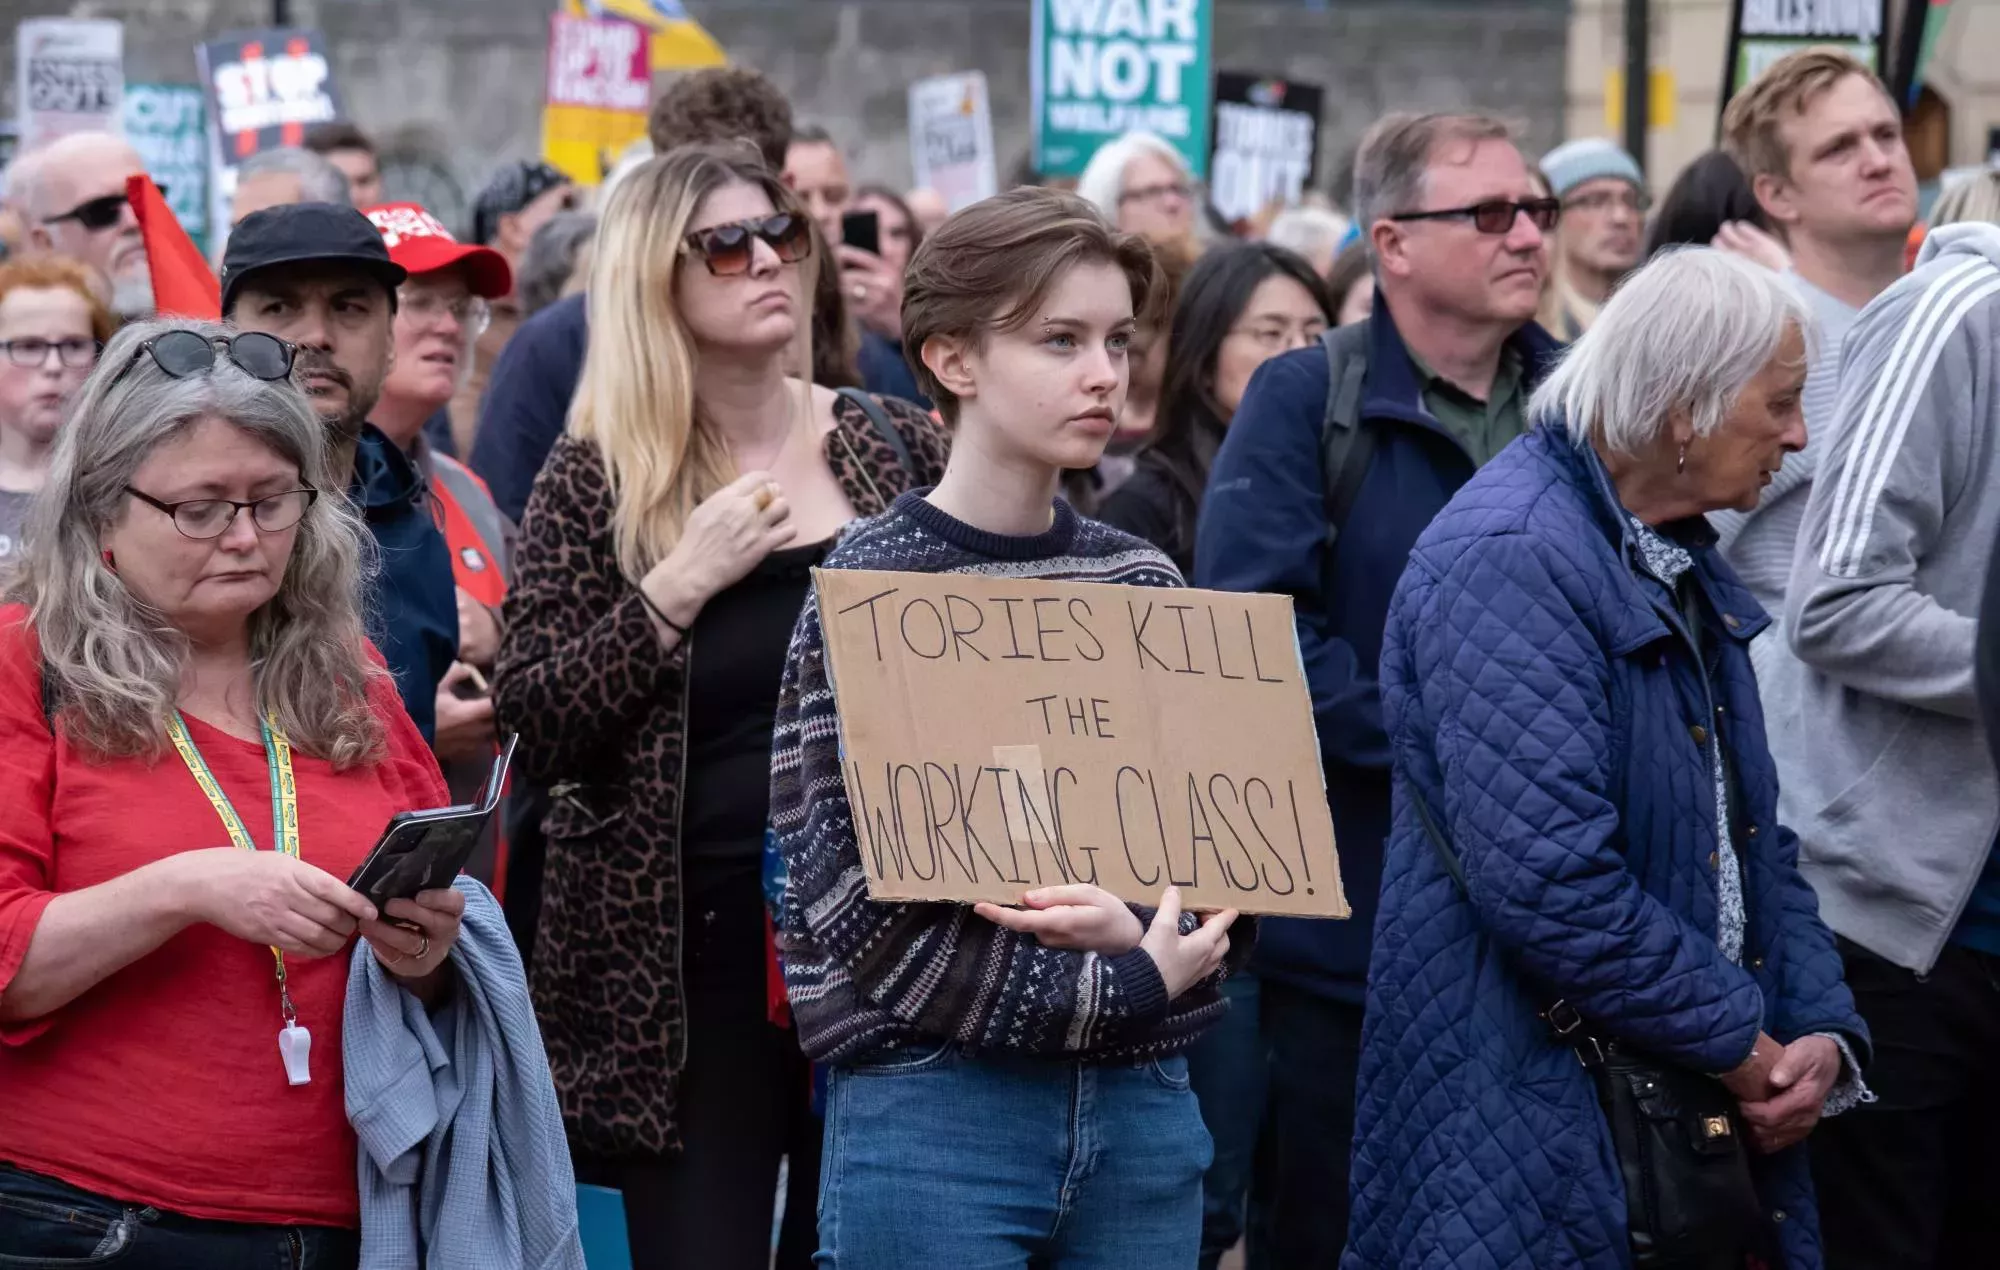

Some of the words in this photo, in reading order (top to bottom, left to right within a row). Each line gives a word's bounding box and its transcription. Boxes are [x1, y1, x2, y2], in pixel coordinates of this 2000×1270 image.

[1051, 0, 1196, 39] WAR
[1052, 37, 1197, 102] NOT
[1051, 103, 1190, 136] WELFARE
[838, 588, 1104, 662] TORIES
[1127, 600, 1284, 683] KILL
[1025, 695, 1116, 739] THE
[853, 761, 1100, 885] WORKING
[1115, 766, 1316, 896] CLASS!
